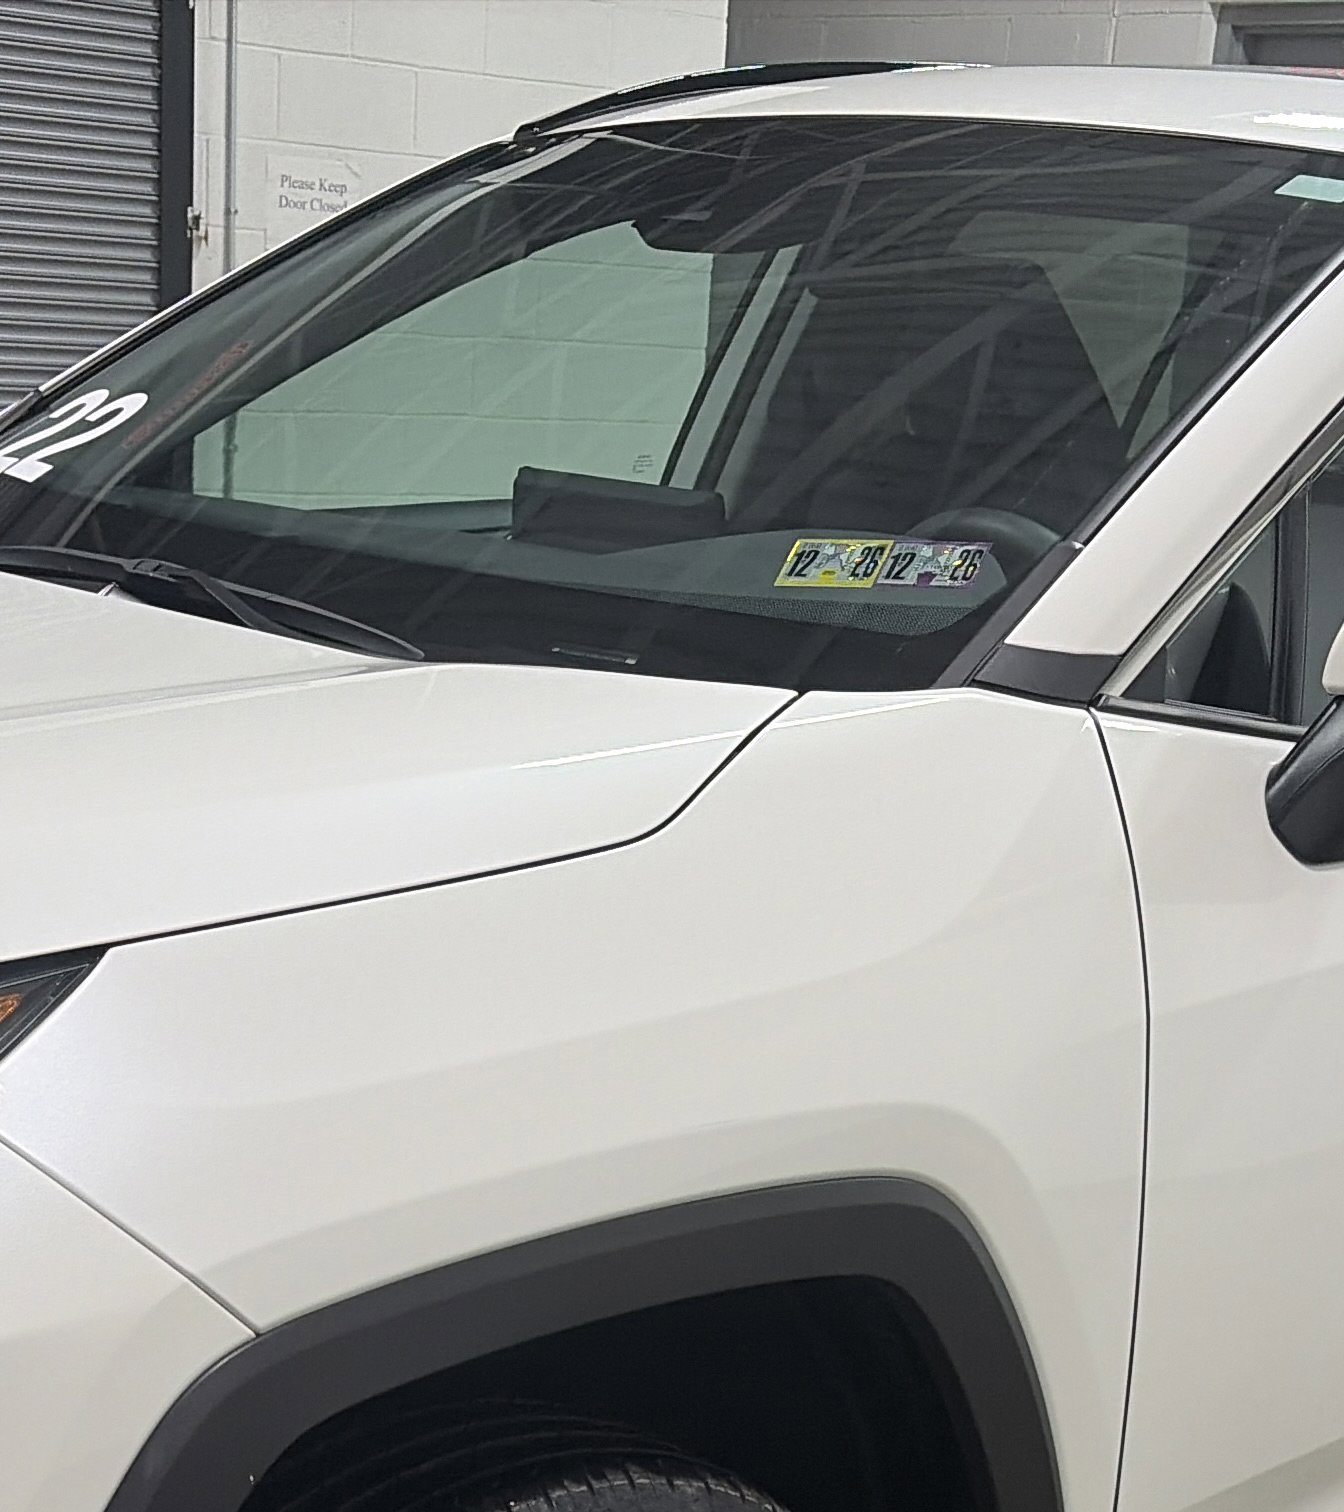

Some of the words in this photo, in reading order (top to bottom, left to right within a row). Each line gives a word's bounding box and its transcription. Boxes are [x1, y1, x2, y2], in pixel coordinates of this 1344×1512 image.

[280, 174, 316, 191] Please
[318, 178, 348, 197] Keep
[278, 195, 308, 211] Door
[787, 549, 820, 577] 12
[884, 552, 917, 580] 12
[948, 548, 985, 581] 26
